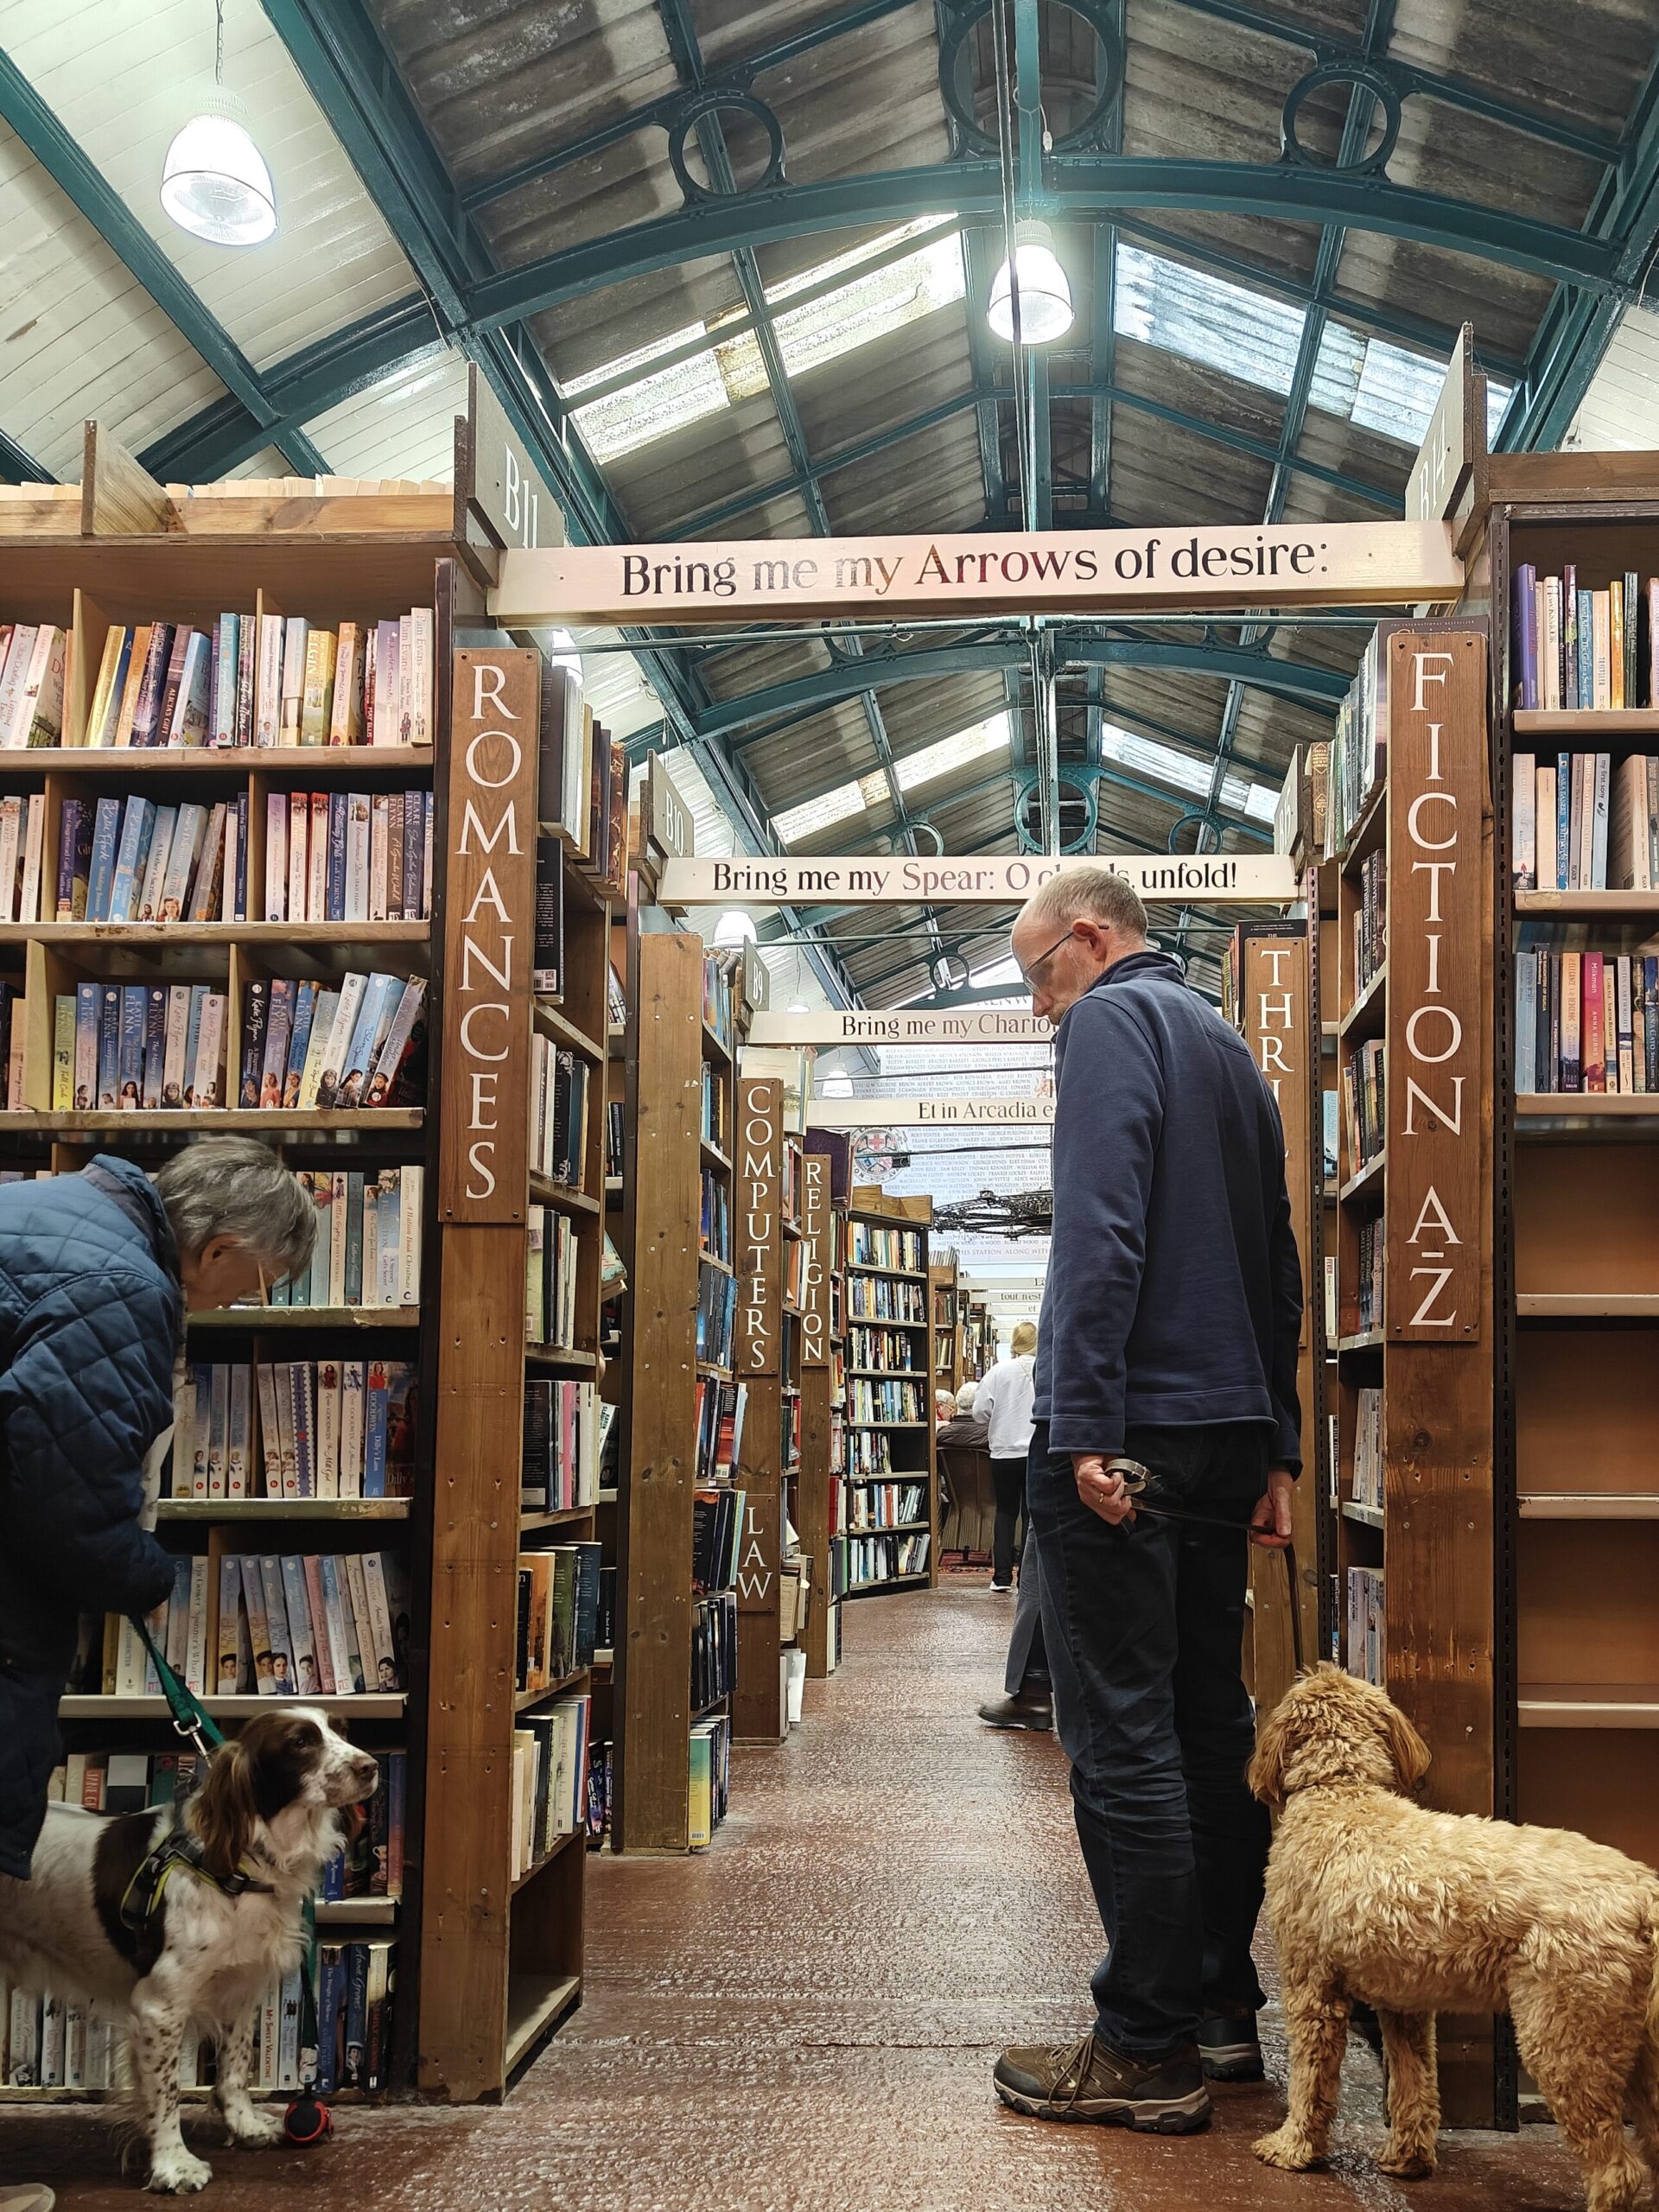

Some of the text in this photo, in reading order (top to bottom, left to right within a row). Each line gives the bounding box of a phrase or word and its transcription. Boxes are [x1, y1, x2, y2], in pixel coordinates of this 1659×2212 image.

[620, 535, 1328, 596] Bring me my Arrows of desire:
[416, 615, 425, 635] Pam
[1547, 586, 1558, 644] HAWKSMOOR
[401, 620, 410, 671] Pam Evans
[416, 639, 426, 665] Evans
[162, 718, 170, 734] GIFT
[1599, 760, 1606, 769] my
[1520, 779, 1529, 805] GUILTY
[1598, 785, 1606, 798] sony
[664, 796, 684, 856] B10
[152, 849, 162, 875] Mother's
[713, 863, 788, 896] Bring
[797, 869, 840, 892] me
[848, 868, 891, 897] my
[902, 863, 995, 897] Spear:
[1005, 862, 1032, 890] O
[1141, 861, 1237, 889] unfold!
[1401, 653, 1463, 1136] FICTION
[454, 664, 524, 1201] ROMANCES
[752, 961, 762, 1002] B9
[125, 995, 135, 1033] FLYNN
[149, 1003, 157, 1038] FLYNN
[246, 998, 264, 1041] Katie Flynn
[269, 998, 280, 1036] FLYNN
[278, 1005, 287, 1031] KATIE
[294, 999, 305, 1034] FLYNN
[842, 1014, 1056, 1039] Bring me my Chario
[391, 1039, 403, 1059] Under
[918, 1101, 1054, 1120] Et in Arcadia e
[742, 1086, 776, 1370] COMPUTERS
[804, 1161, 823, 1363] RELIGION
[323, 1452, 333, 1469] Mill
[736, 1504, 773, 1600] LAW
[194, 1579, 203, 1605] Gower
[190, 1611, 201, 1649] Spinner's
[85, 1771, 99, 1793] JANE
[353, 1947, 365, 2011] Annie Groves
[264, 2009, 274, 2078] MY SWEET VALENTINE
